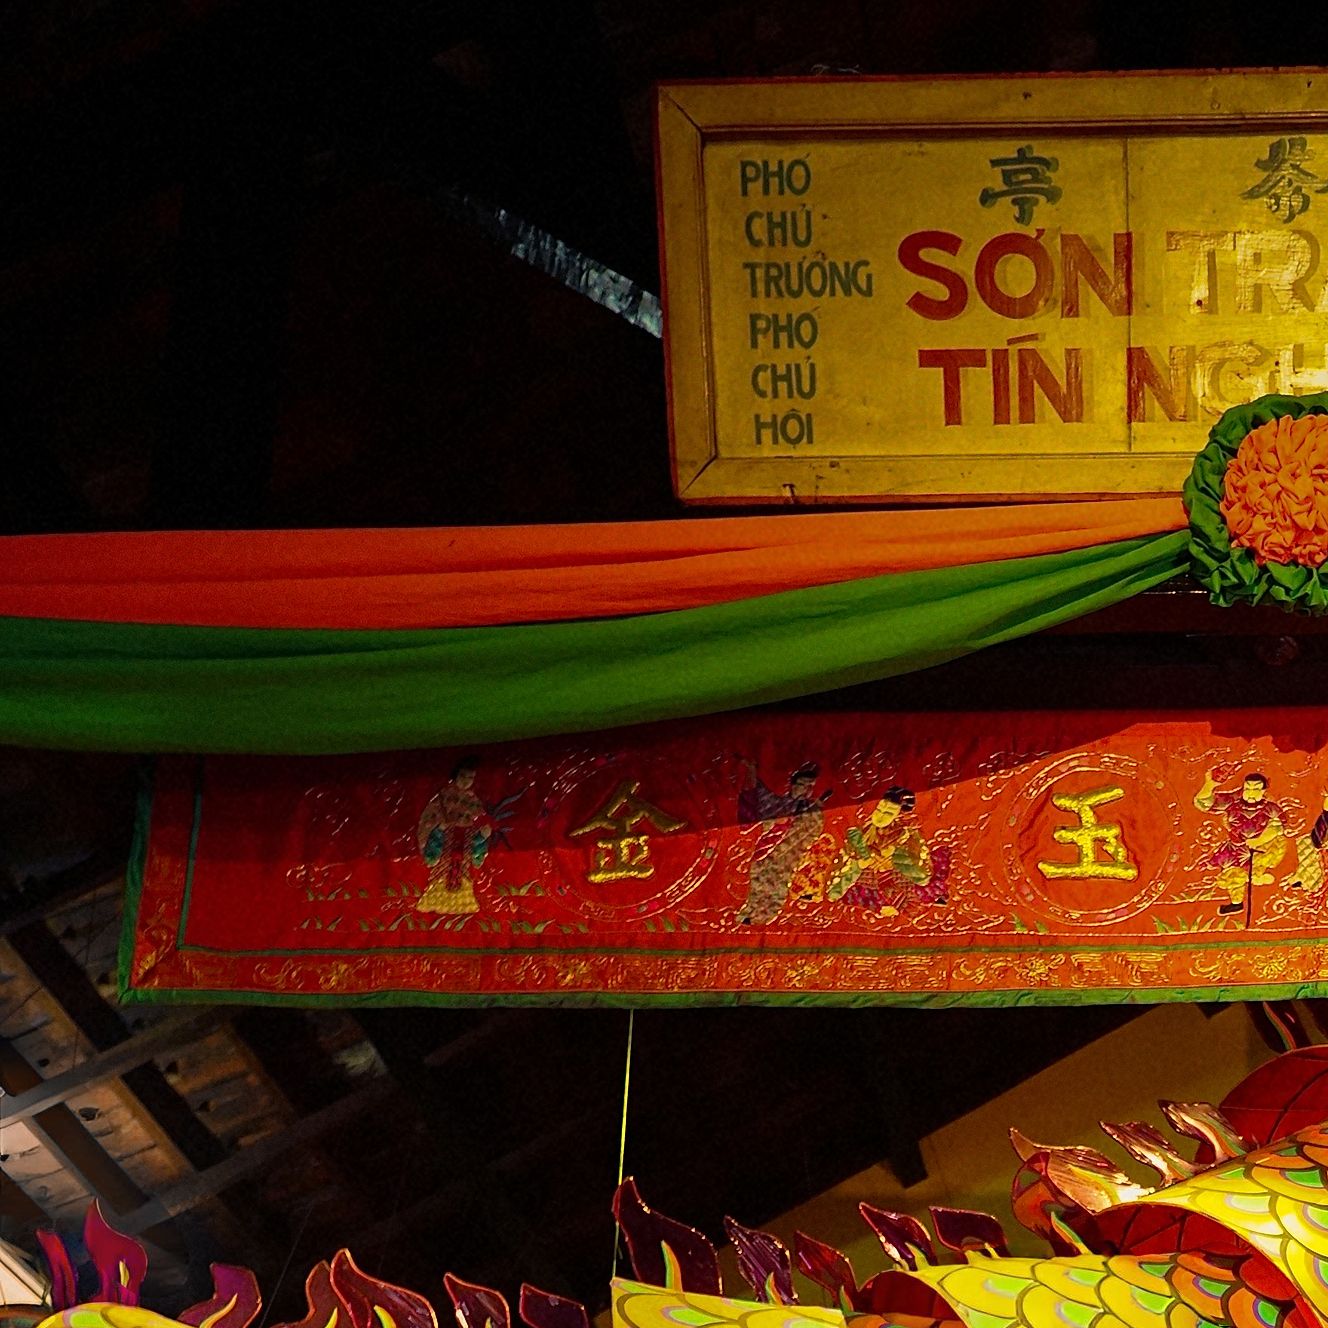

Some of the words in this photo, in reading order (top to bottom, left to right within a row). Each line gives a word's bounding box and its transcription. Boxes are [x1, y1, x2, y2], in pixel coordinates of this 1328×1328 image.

[740, 152, 812, 197] PHÓ
[979, 144, 1063, 227] 亭
[897, 228, 1134, 321] SƠN
[749, 305, 820, 350] PHÓ
[918, 333, 1084, 426] TÍN
[569, 779, 688, 883] 金
[1038, 785, 1138, 880] 玉
